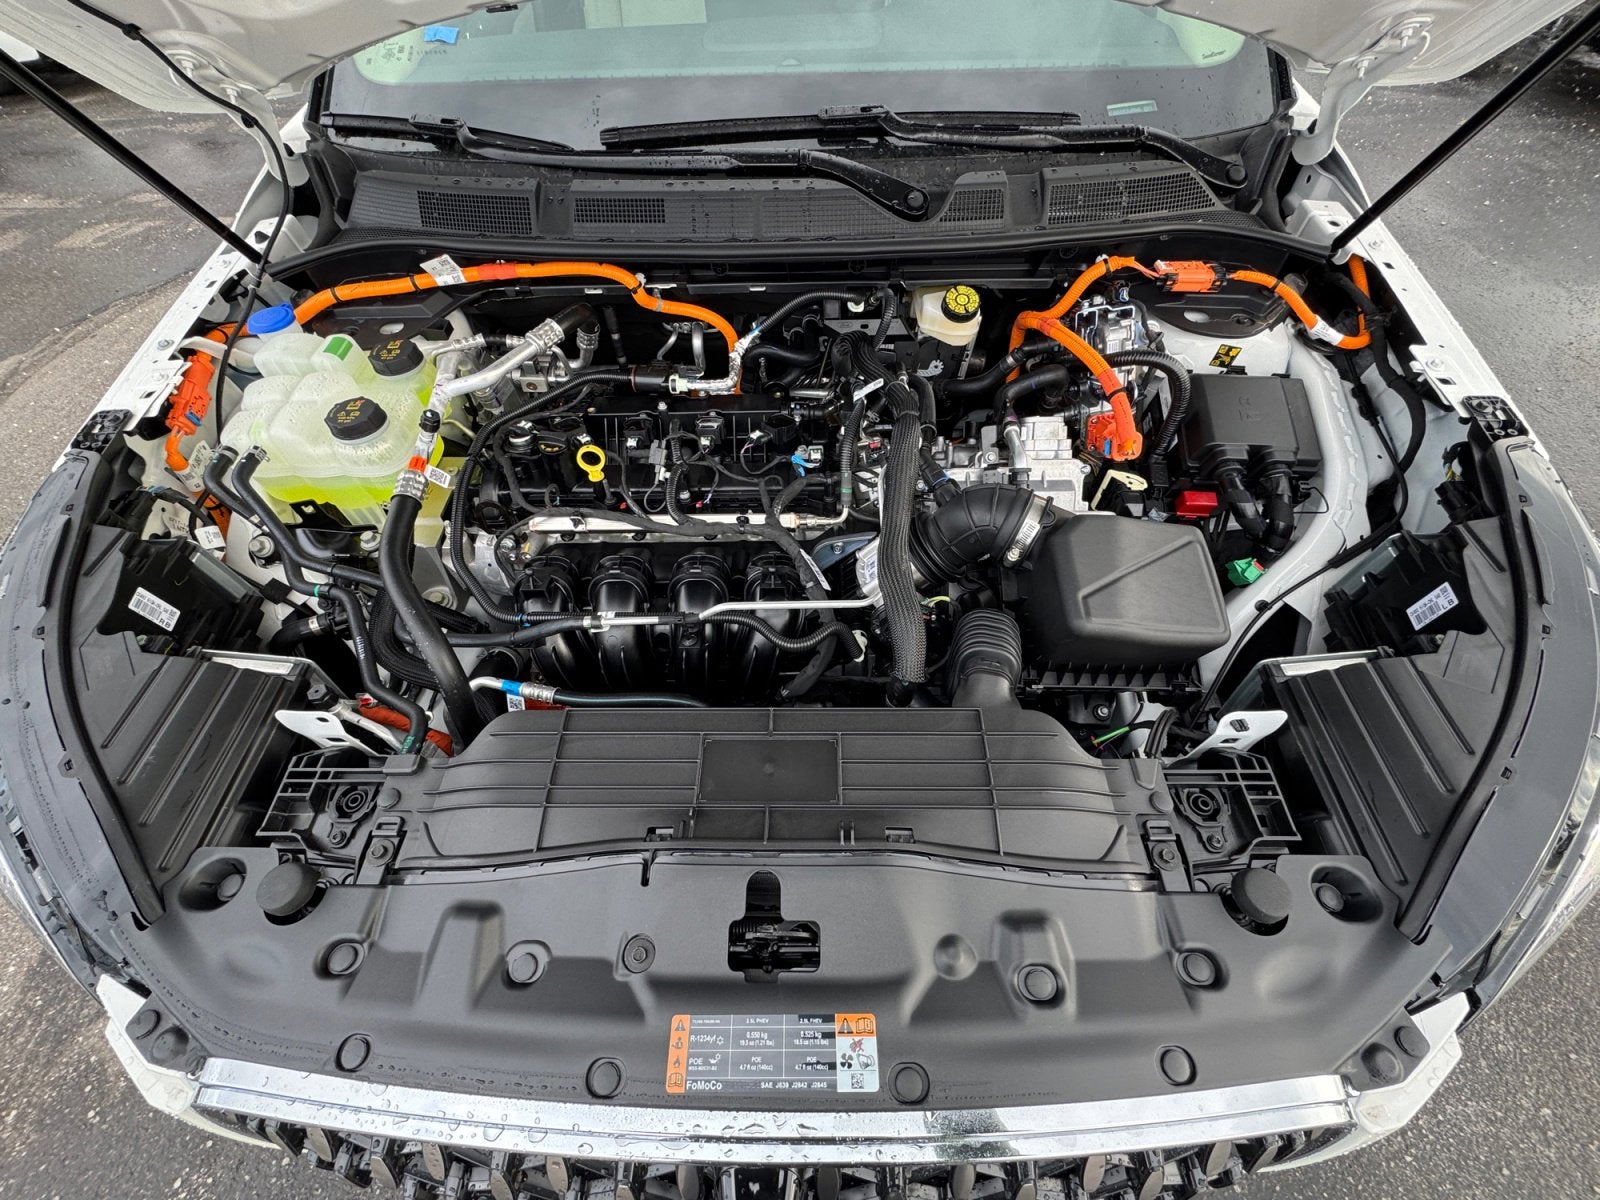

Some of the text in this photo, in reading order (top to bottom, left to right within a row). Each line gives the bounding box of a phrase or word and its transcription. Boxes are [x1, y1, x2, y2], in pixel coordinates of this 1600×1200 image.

[690, 1034, 717, 1044] R-1234yf
[761, 1031, 768, 1040] kg
[814, 1031, 822, 1039] kg
[686, 1081, 723, 1090] FoMoCo
